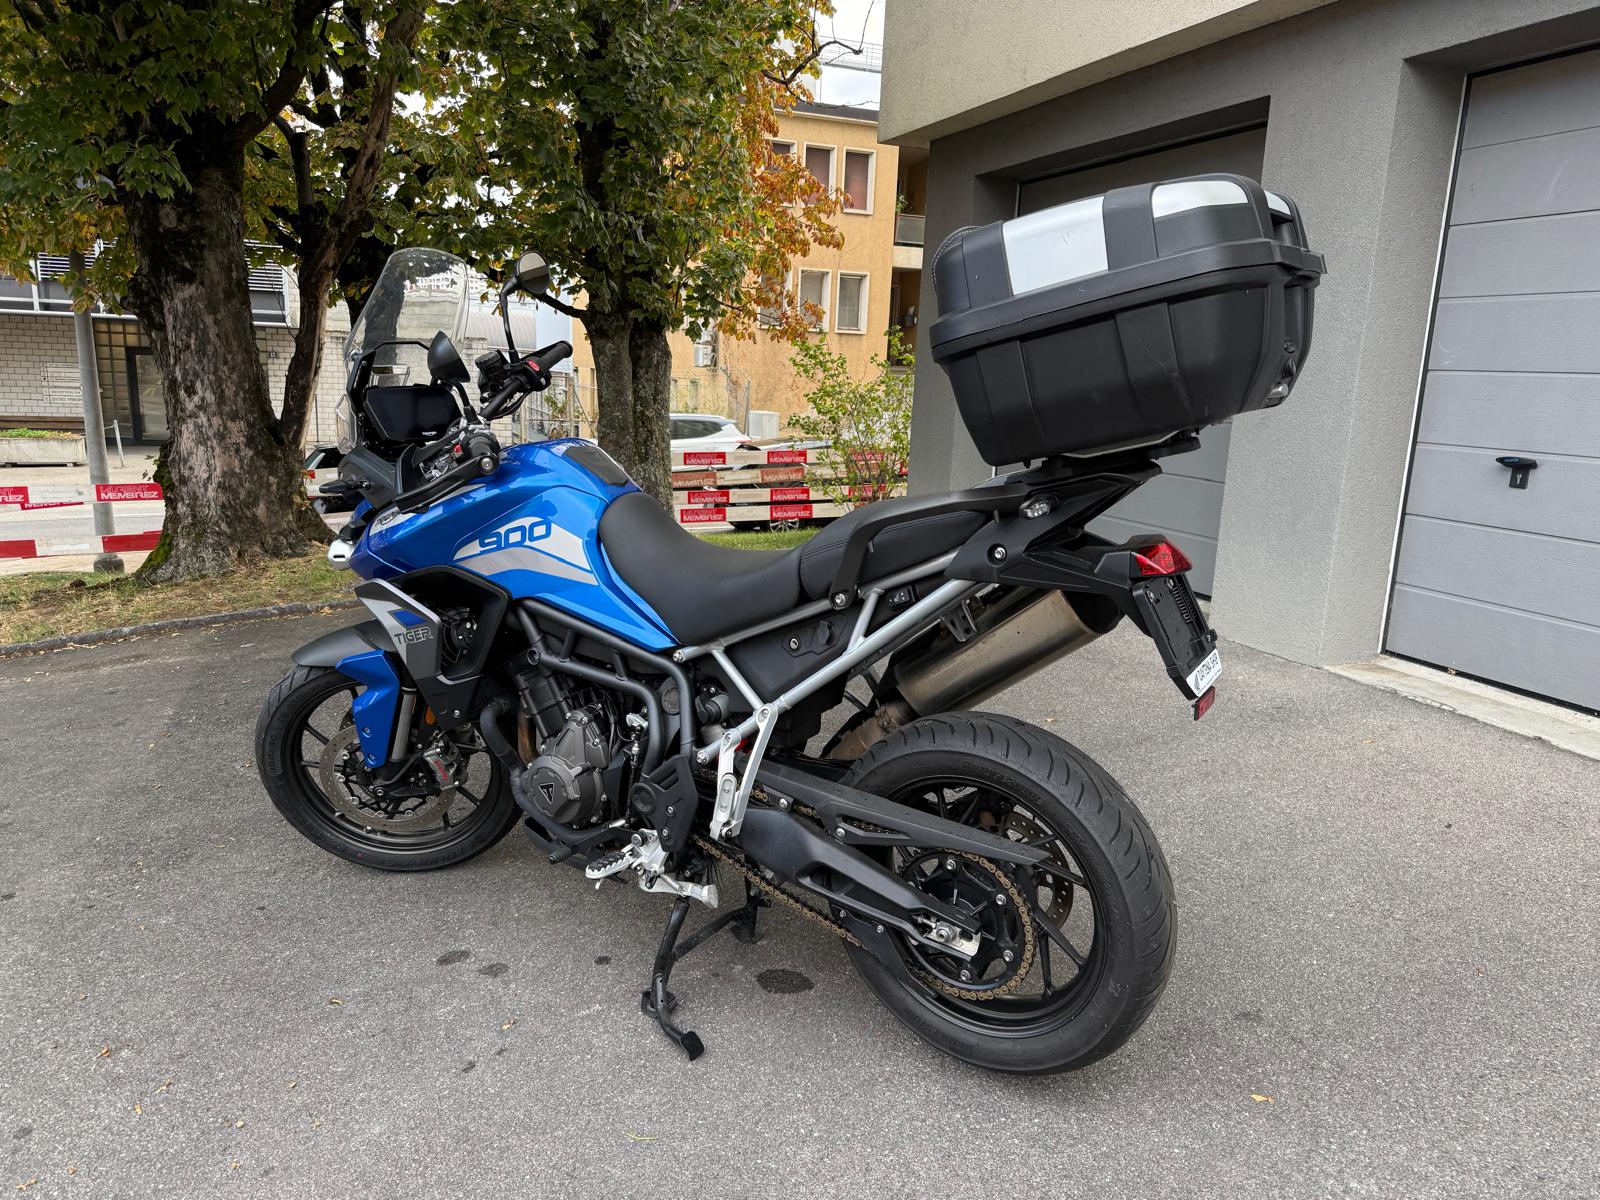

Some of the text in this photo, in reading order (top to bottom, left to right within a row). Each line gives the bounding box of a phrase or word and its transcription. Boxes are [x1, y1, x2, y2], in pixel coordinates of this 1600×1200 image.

[101, 491, 159, 500] MEMBREZ
[478, 519, 553, 554] 900
[393, 626, 434, 645] TIGER
